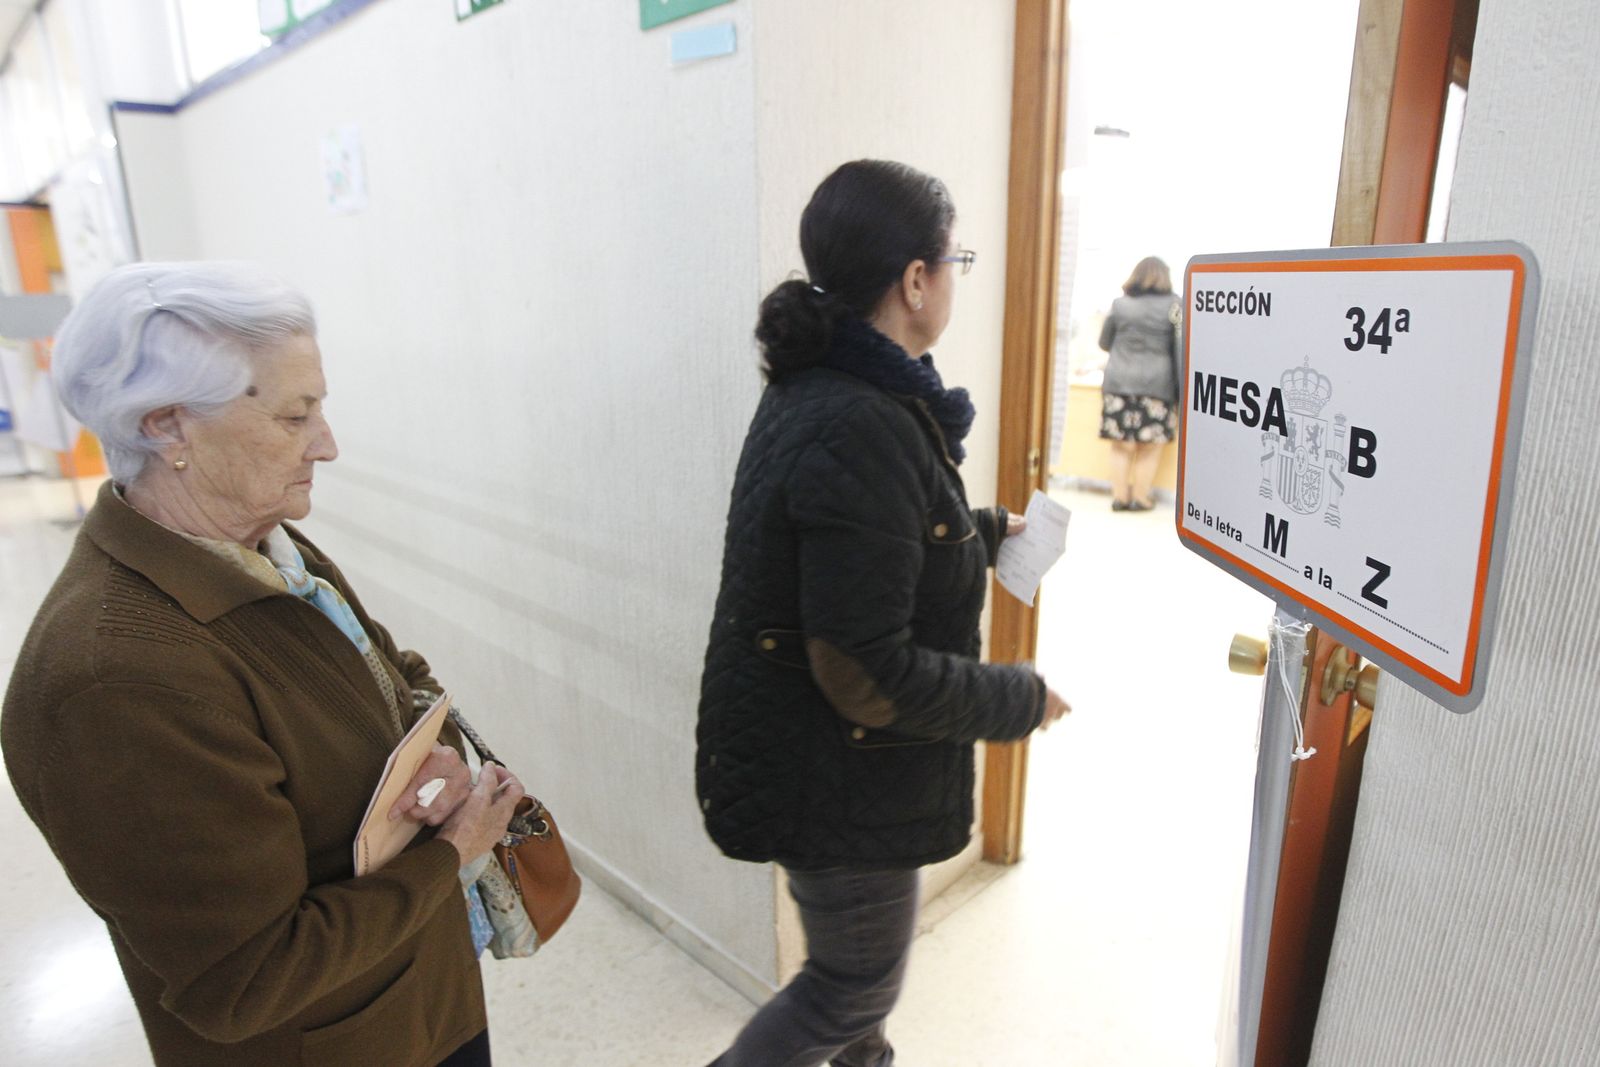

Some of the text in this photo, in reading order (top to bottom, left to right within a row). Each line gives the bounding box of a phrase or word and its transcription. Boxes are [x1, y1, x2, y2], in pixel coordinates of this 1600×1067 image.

[1195, 286, 1271, 316] SECCIÓN
[1193, 371, 1377, 479] MESA B
[1187, 502, 1391, 610] De la letra M a la Z
